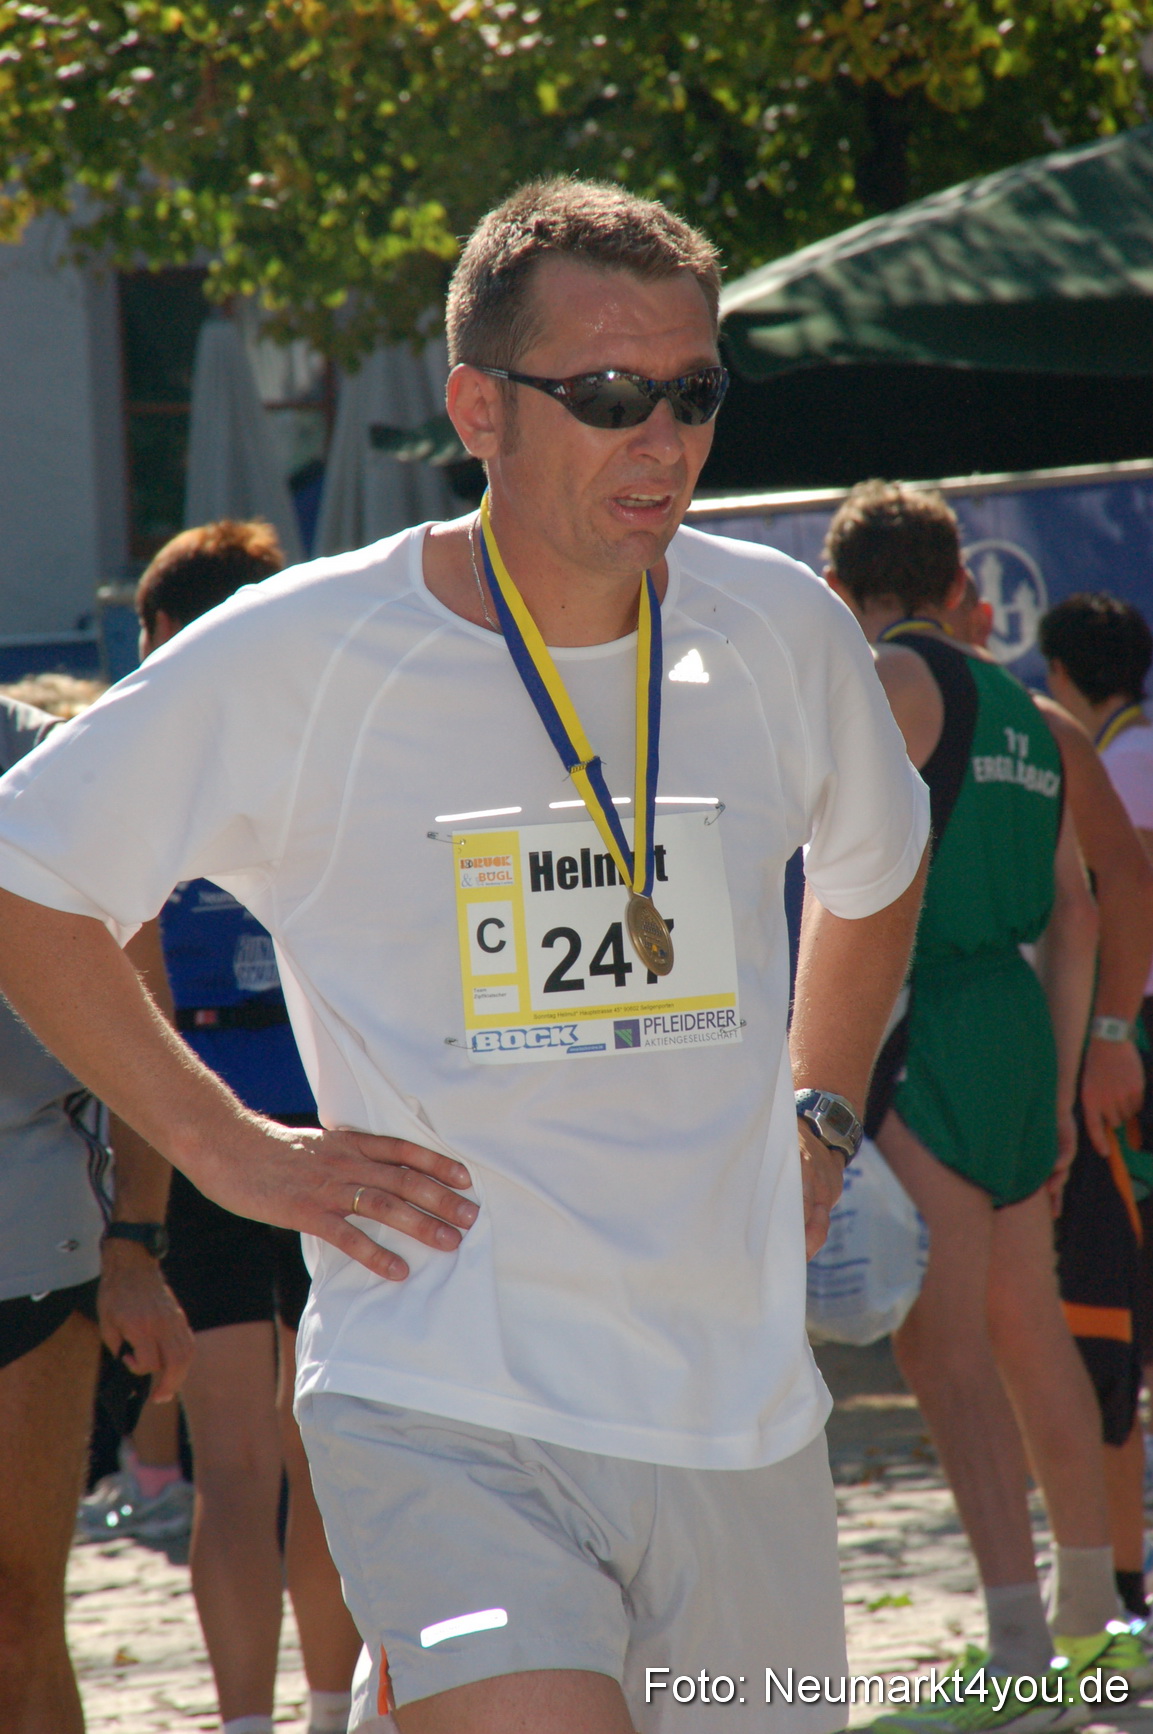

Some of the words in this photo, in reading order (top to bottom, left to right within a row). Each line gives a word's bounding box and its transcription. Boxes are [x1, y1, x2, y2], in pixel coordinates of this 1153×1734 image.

[528, 845, 669, 892] Helmt
[476, 917, 507, 953] C
[643, 1009, 737, 1036] PFLEIDERER
[472, 1024, 579, 1053] BOCK
[644, 1030, 739, 1048] AKTIENGESELLSCHAFT
